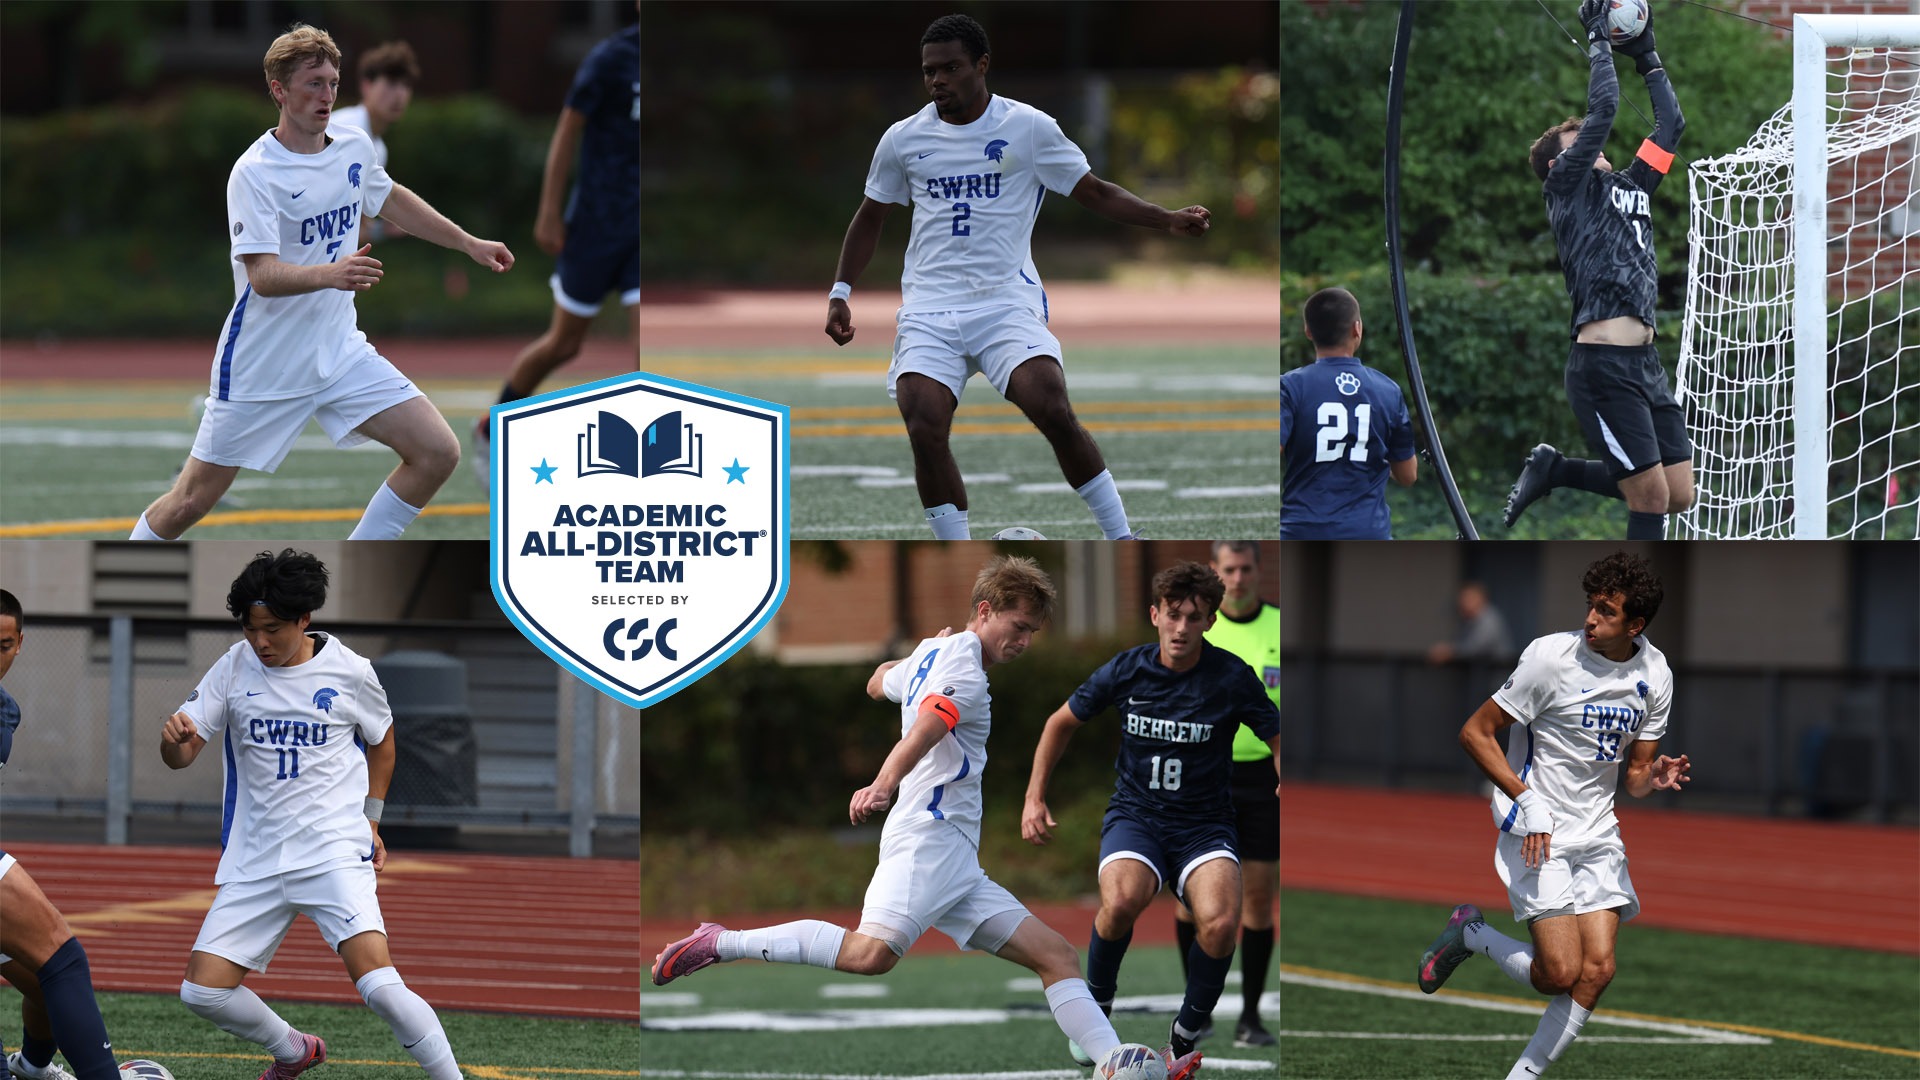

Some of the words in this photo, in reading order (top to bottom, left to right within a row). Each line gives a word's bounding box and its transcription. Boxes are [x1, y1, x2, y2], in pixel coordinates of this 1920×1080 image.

[926, 172, 1002, 199] CWRU
[951, 202, 971, 237] 2
[1632, 219, 1646, 249] 1
[326, 240, 343, 263] 7
[1315, 402, 1371, 463] 21
[905, 647, 941, 707] 8
[249, 718, 330, 747] CWRU
[1126, 712, 1214, 743] BEHREND
[1581, 704, 1644, 733] CWRU
[1595, 732, 1622, 762] 13
[275, 747, 300, 781] 11
[1149, 755, 1183, 792] 18
